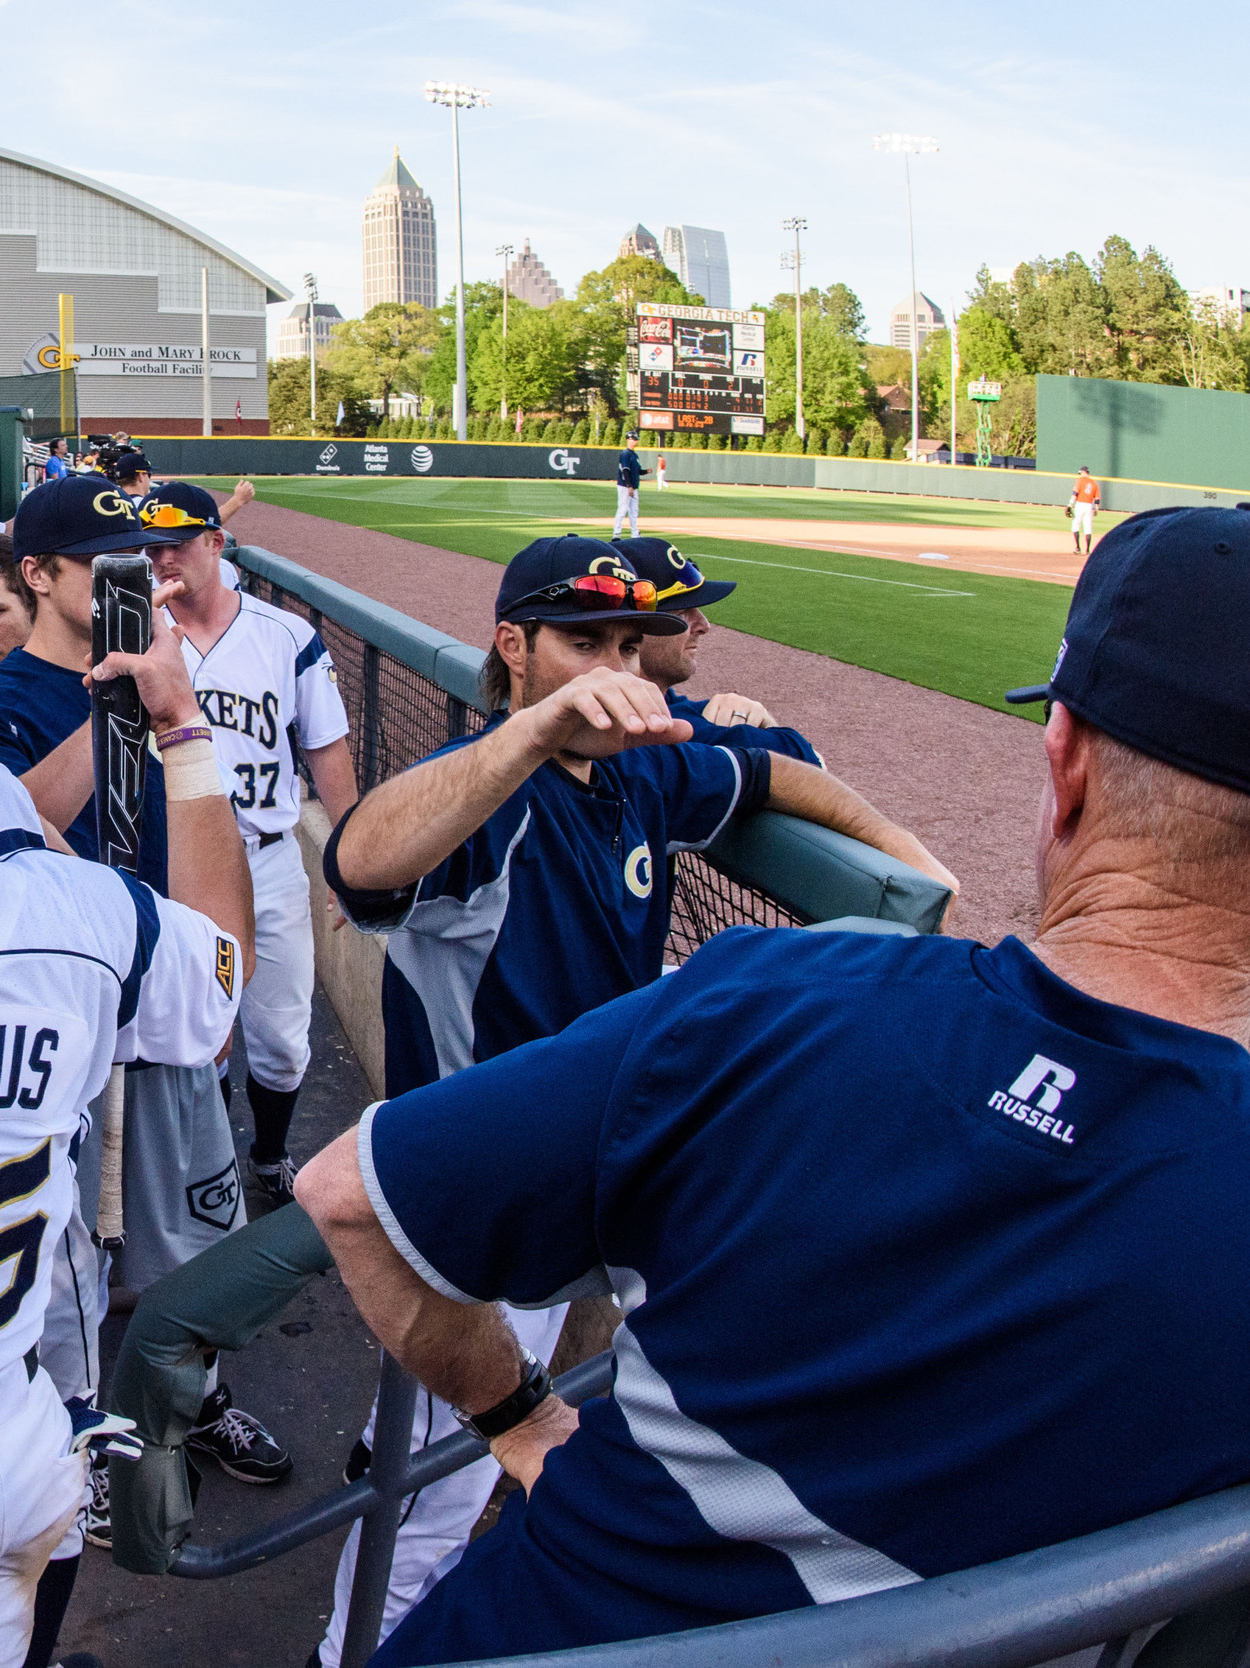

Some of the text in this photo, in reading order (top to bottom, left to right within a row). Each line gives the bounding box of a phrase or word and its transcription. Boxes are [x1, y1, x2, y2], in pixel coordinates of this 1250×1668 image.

[658, 305, 749, 323] GEORGIA TECH
[91, 345, 126, 357] JOHN
[131, 349, 152, 358] and
[158, 346, 195, 359] MARY
[122, 363, 213, 375] Football Facili
[366, 463, 387, 471] Center
[549, 449, 581, 475] GT
[93, 490, 136, 520] GT
[1203, 491, 1218, 499] 390
[230, 761, 279, 809] 37
[216, 937, 234, 998] ACC
[987, 1090, 1075, 1144] RUSSELL
[199, 1181, 236, 1211] GT
